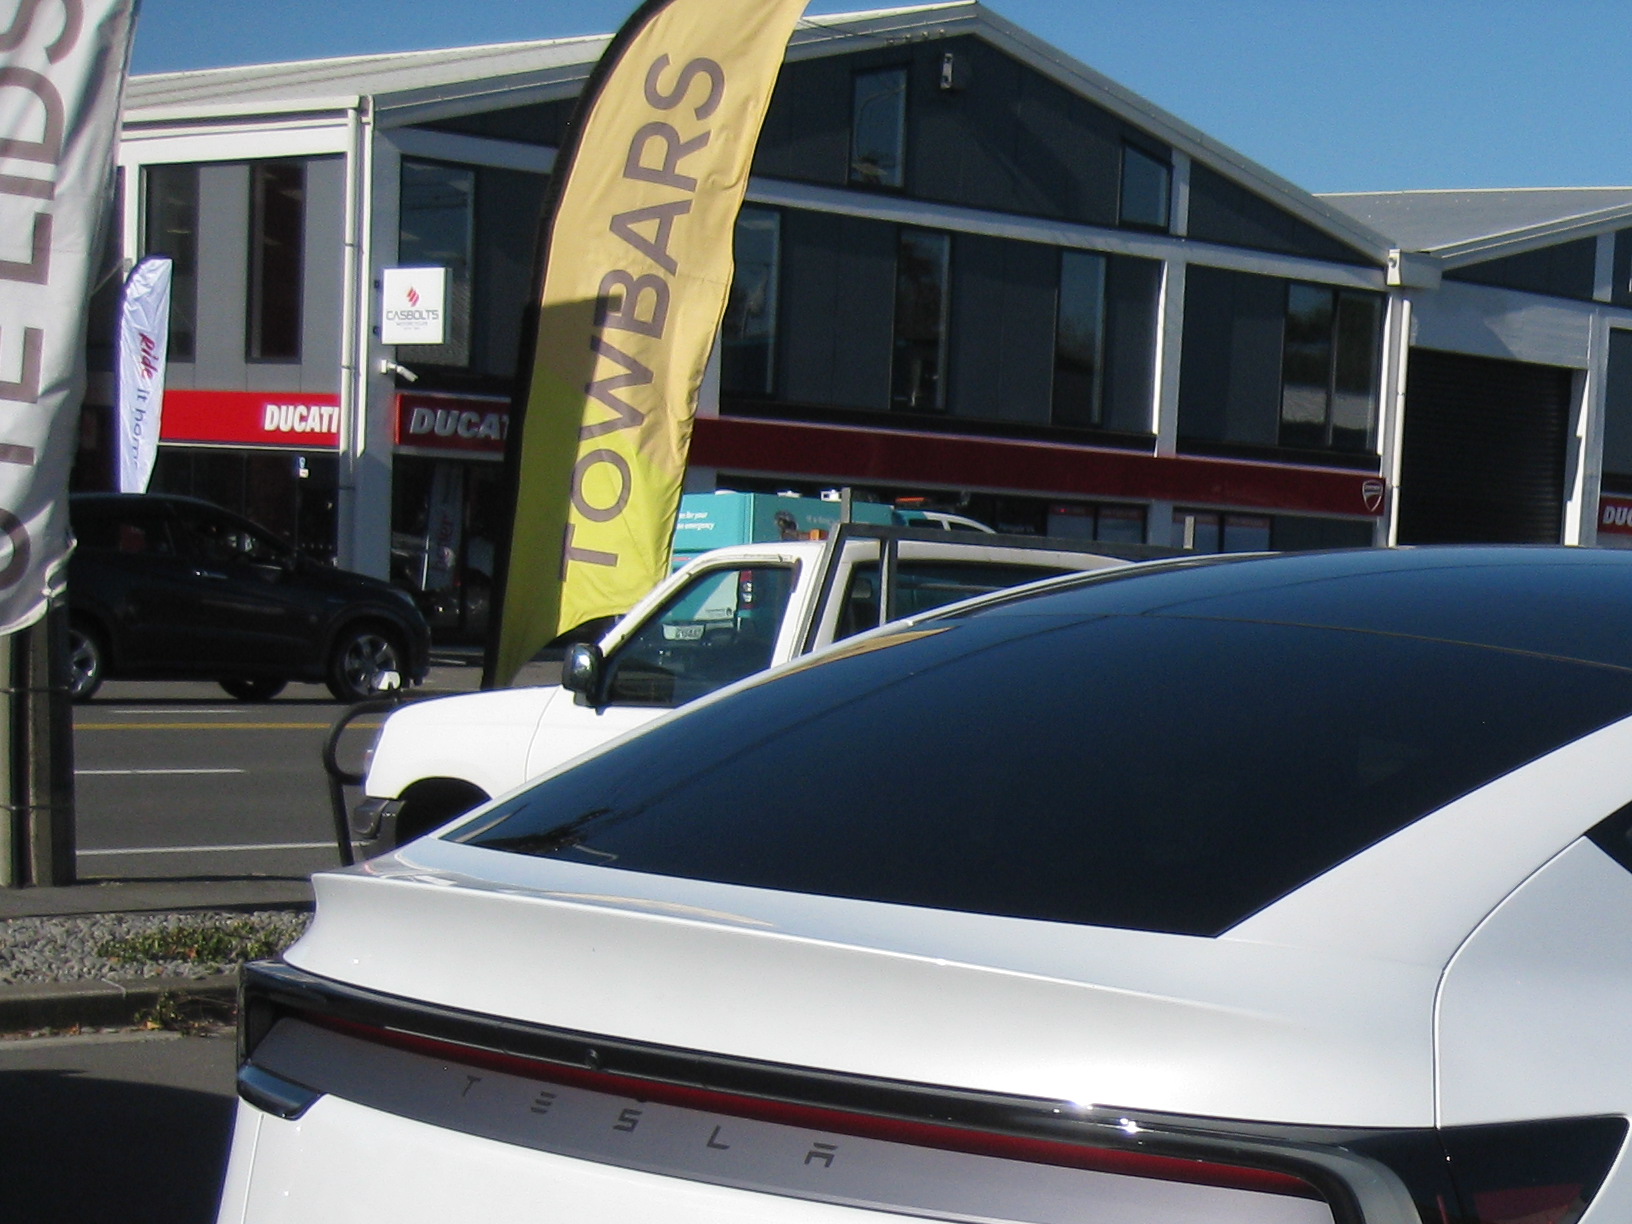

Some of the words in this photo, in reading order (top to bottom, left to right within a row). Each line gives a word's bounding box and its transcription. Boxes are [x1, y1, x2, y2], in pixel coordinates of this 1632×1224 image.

[386, 309, 440, 321] CASBOLTS
[558, 52, 726, 581] TOWBARS
[138, 332, 159, 380] Ride
[264, 404, 340, 433] DUCATI
[461, 1074, 839, 1169] TESLA
